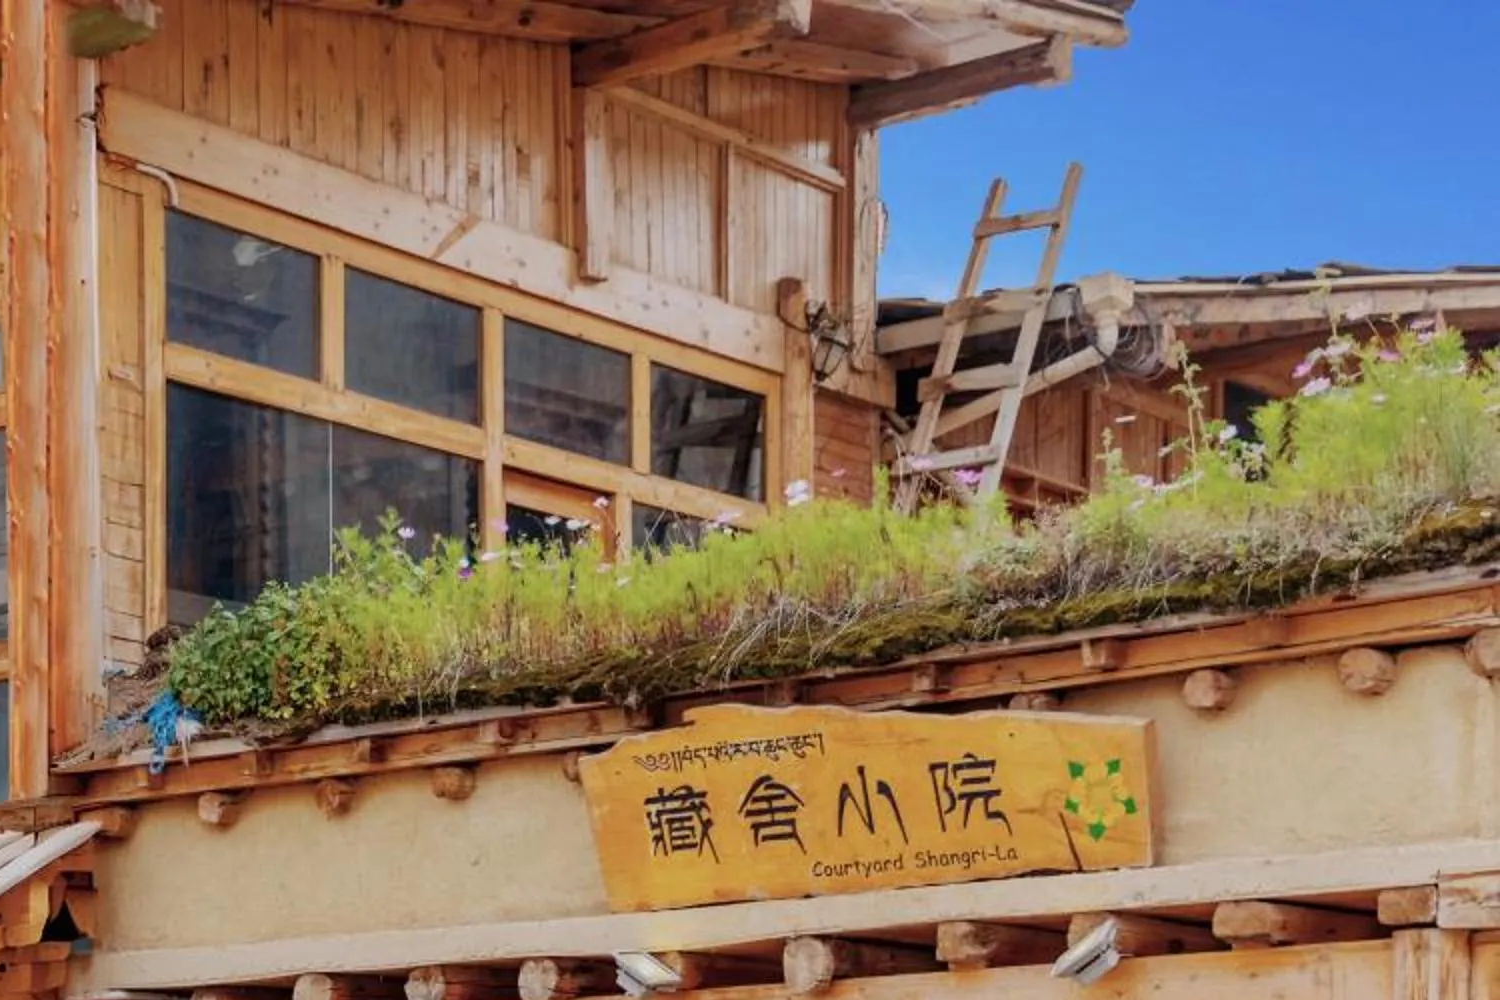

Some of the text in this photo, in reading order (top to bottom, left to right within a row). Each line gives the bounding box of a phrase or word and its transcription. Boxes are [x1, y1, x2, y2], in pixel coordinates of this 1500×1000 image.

[644, 752, 1013, 864] 藏舍小院
[811, 845, 1019, 879] Courtyard Shangri-La
